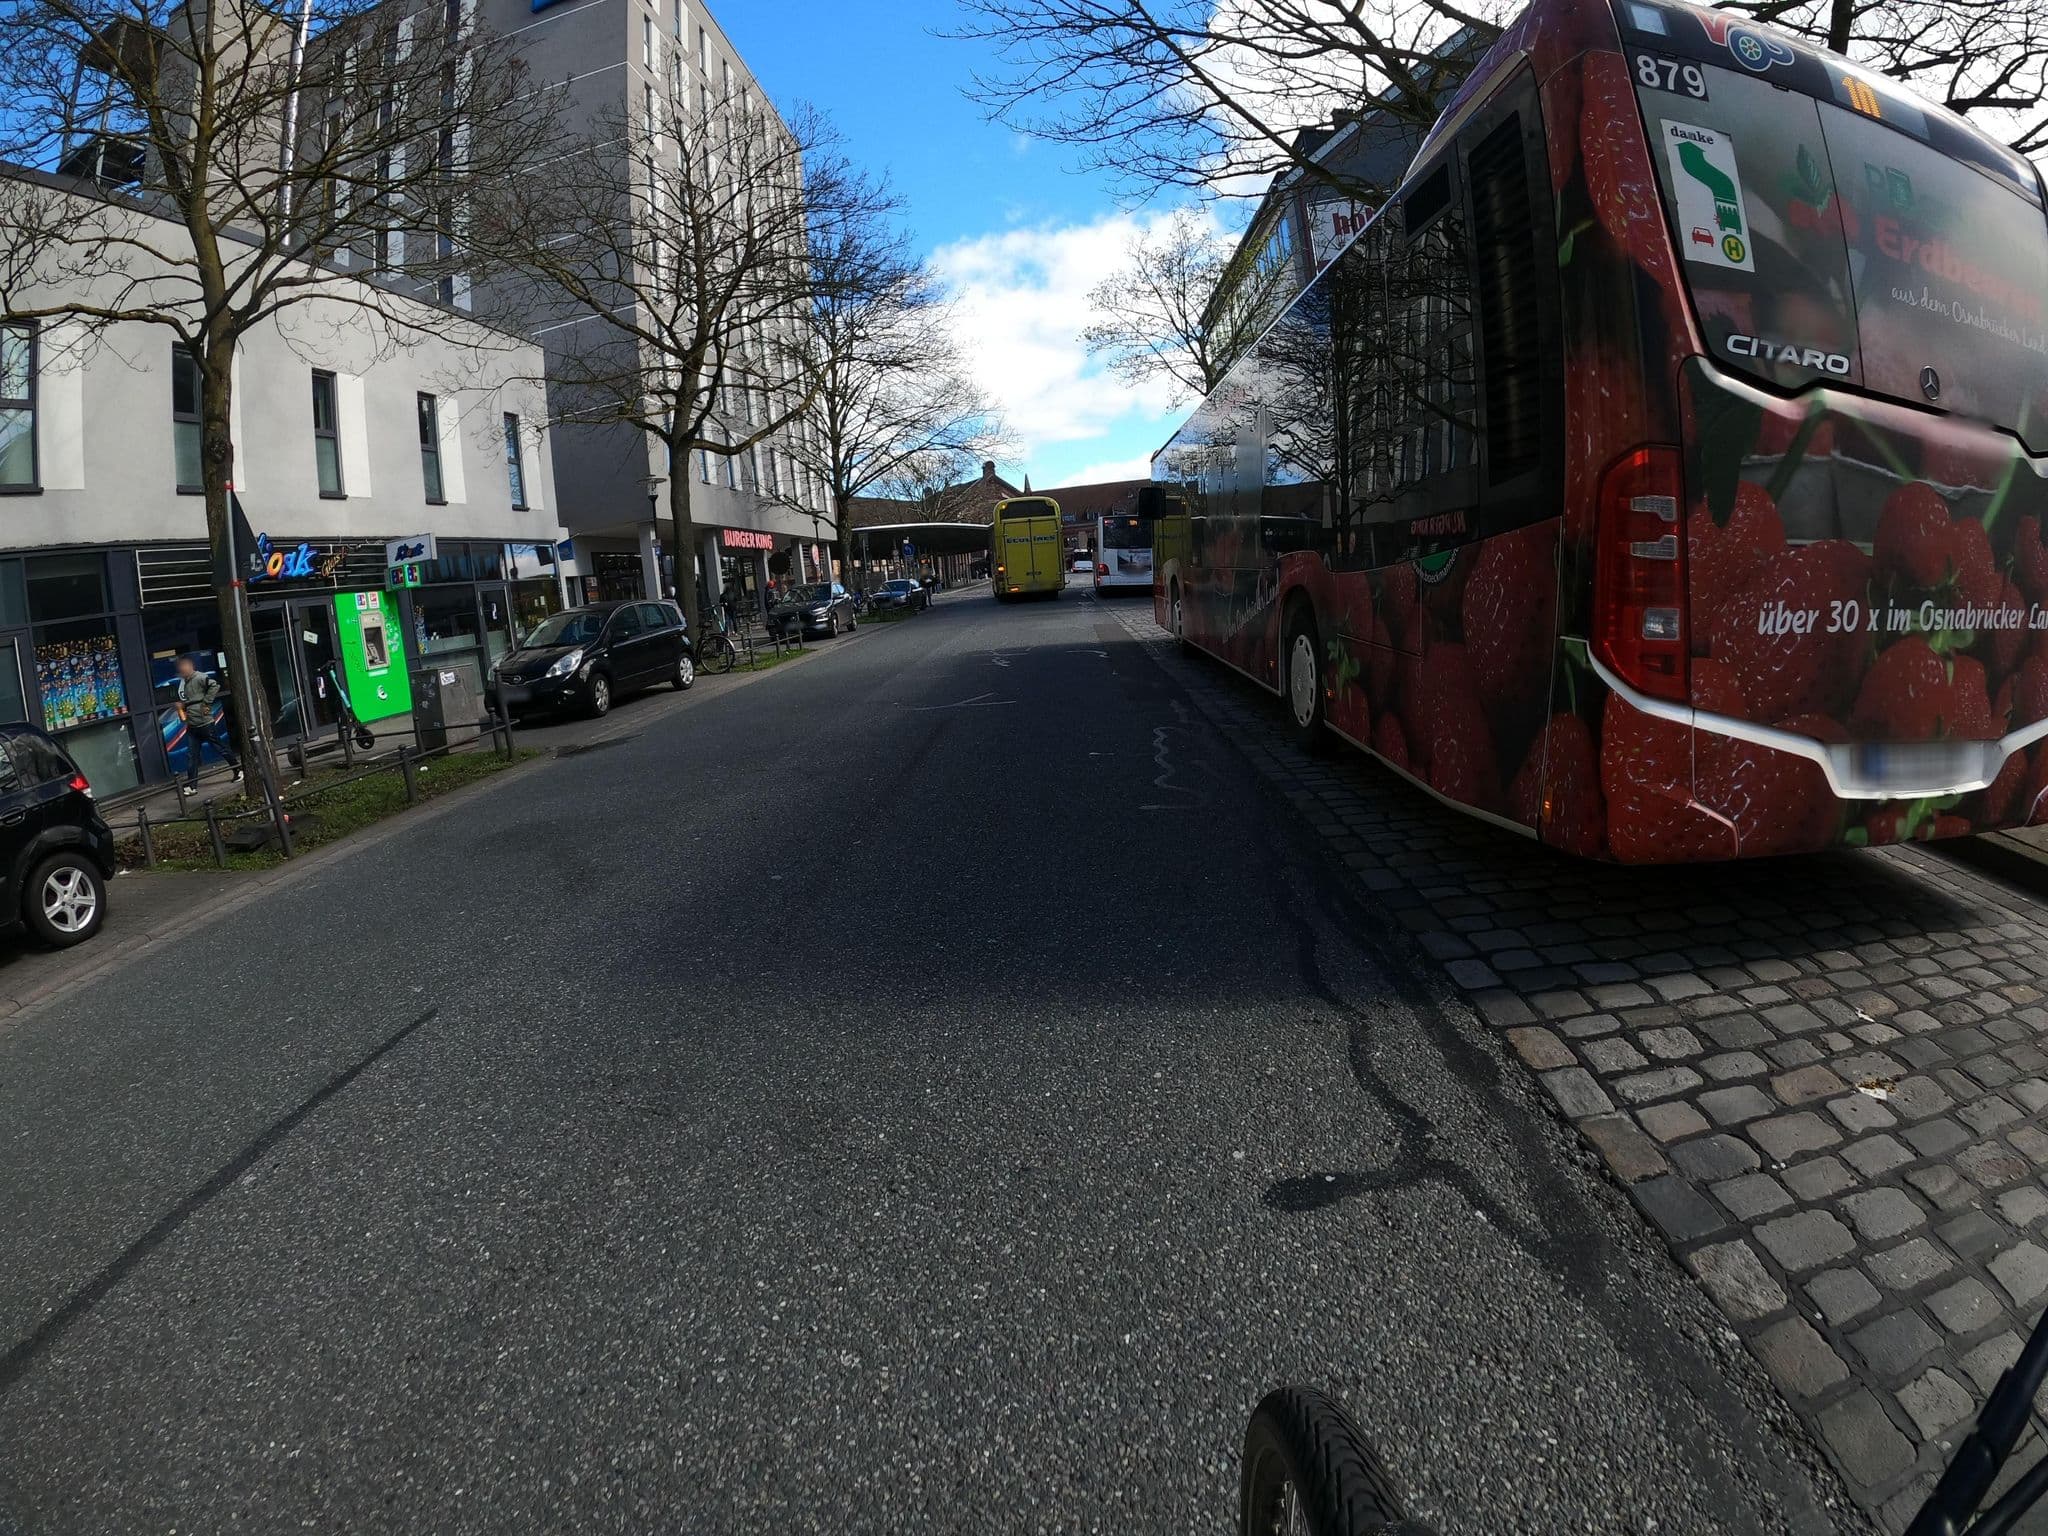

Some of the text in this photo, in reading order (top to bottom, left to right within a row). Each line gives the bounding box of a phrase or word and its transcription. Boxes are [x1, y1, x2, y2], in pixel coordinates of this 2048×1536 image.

[1636, 54, 1706, 98] 879
[1670, 125, 1715, 145] danke
[1891, 286, 1918, 307] aus
[1920, 286, 1951, 317] dem
[1726, 334, 1850, 374] CITARO
[723, 529, 773, 549] BURGER KING
[1757, 600, 1820, 635] über
[1826, 599, 1860, 633] 30
[1866, 608, 1881, 632] x
[1886, 598, 1911, 632] im
[1919, 599, 2025, 632] Osnabrücker
